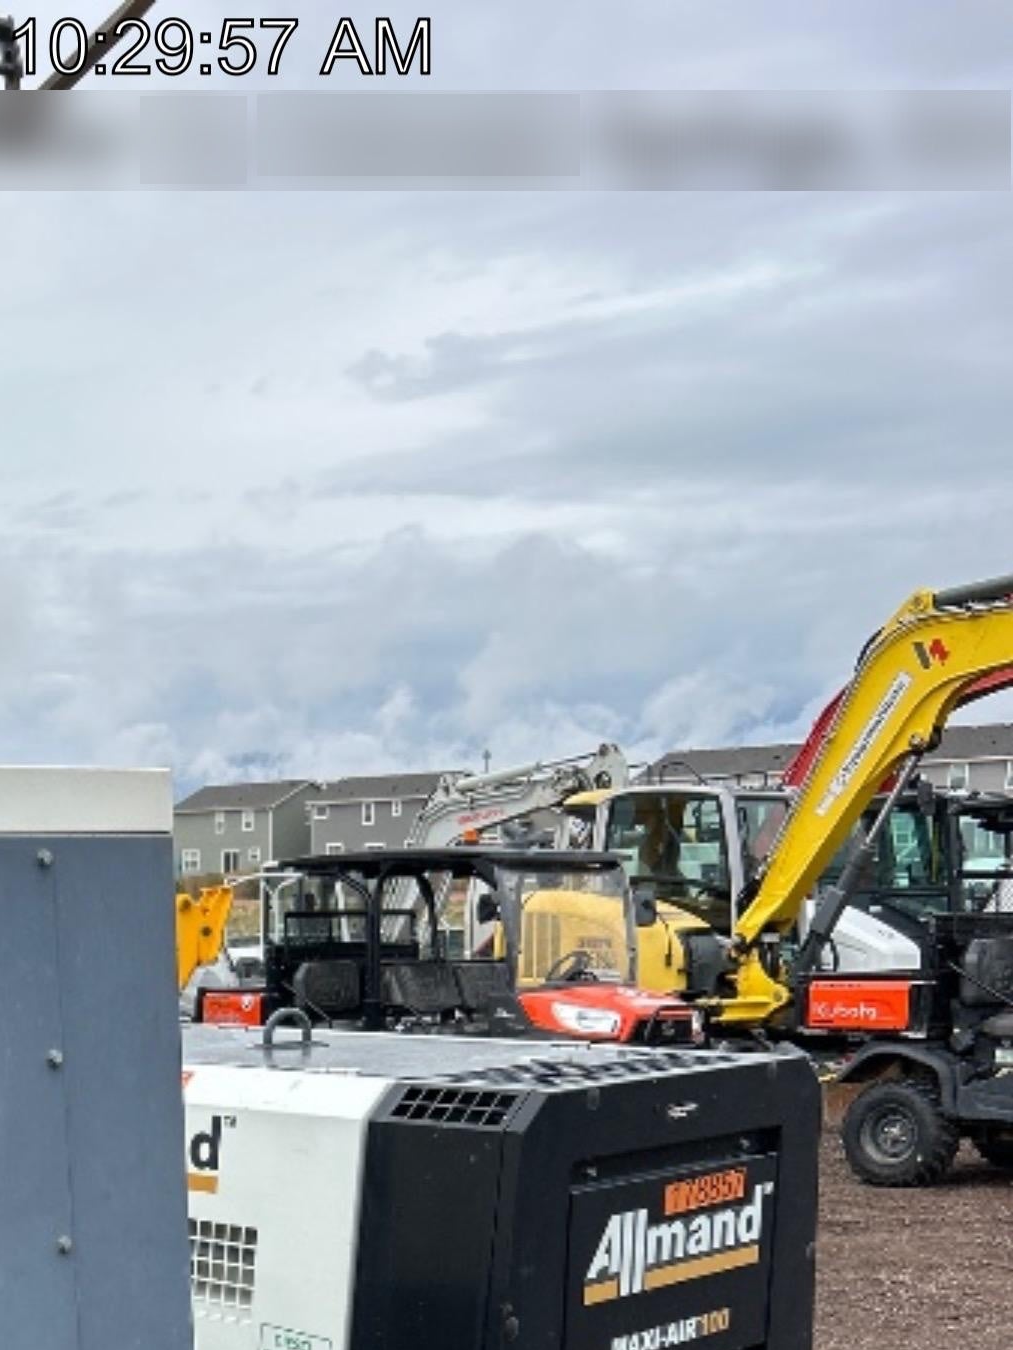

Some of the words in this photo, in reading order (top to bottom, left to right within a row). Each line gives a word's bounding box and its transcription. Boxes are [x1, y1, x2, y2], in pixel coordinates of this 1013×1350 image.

[810, 1001, 877, 1020] Kubota
[587, 1183, 762, 1297] Allmand
[701, 1307, 730, 1336] 100
